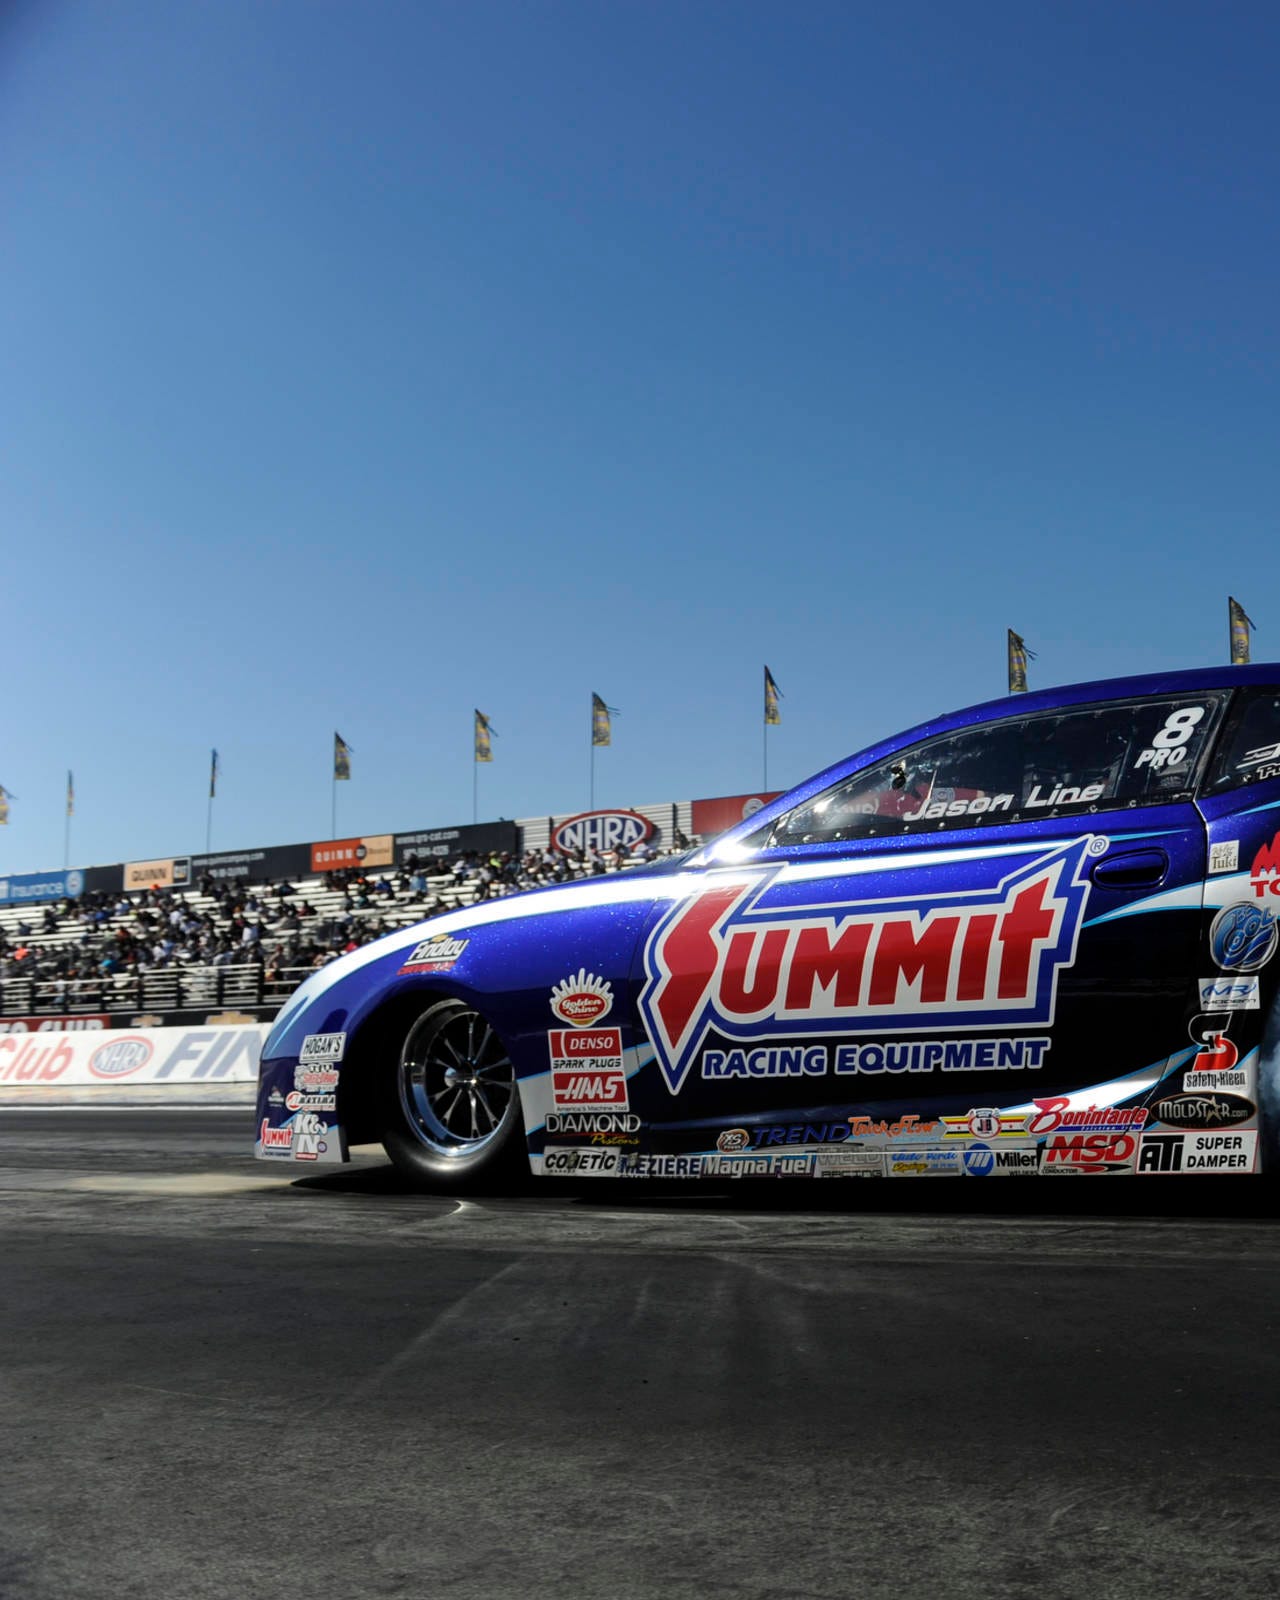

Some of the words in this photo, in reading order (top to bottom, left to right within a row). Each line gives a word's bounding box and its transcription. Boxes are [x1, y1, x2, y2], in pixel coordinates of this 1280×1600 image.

[1153, 706, 1205, 749] 8
[1134, 747, 1188, 769] PRO
[903, 792, 1014, 821] Jason
[1024, 783, 1105, 809] Line
[564, 817, 640, 850] NHRA
[561, 997, 603, 1010] Golden
[565, 1005, 600, 1016] Shine
[303, 1036, 342, 1056] HOGAN'S
[569, 1036, 614, 1051] DENSO
[96, 1041, 148, 1073] NHRA
[552, 1058, 585, 1070] SPARK
[588, 1057, 622, 1068] PLUGS
[703, 1049, 826, 1078] RACING
[836, 1038, 1051, 1074] EQUIPMENT
[555, 1075, 624, 1101] HAAS
[545, 1113, 642, 1134] DIAMOND
[591, 1133, 641, 1146] Pistons
[752, 1123, 851, 1146] TREND
[1196, 1136, 1242, 1150] SUPER
[1046, 1134, 1136, 1163] MSD
[1138, 1135, 1185, 1172] ATI
[996, 1152, 1037, 1167] Miller
[1187, 1154, 1247, 1168] DAMPER
